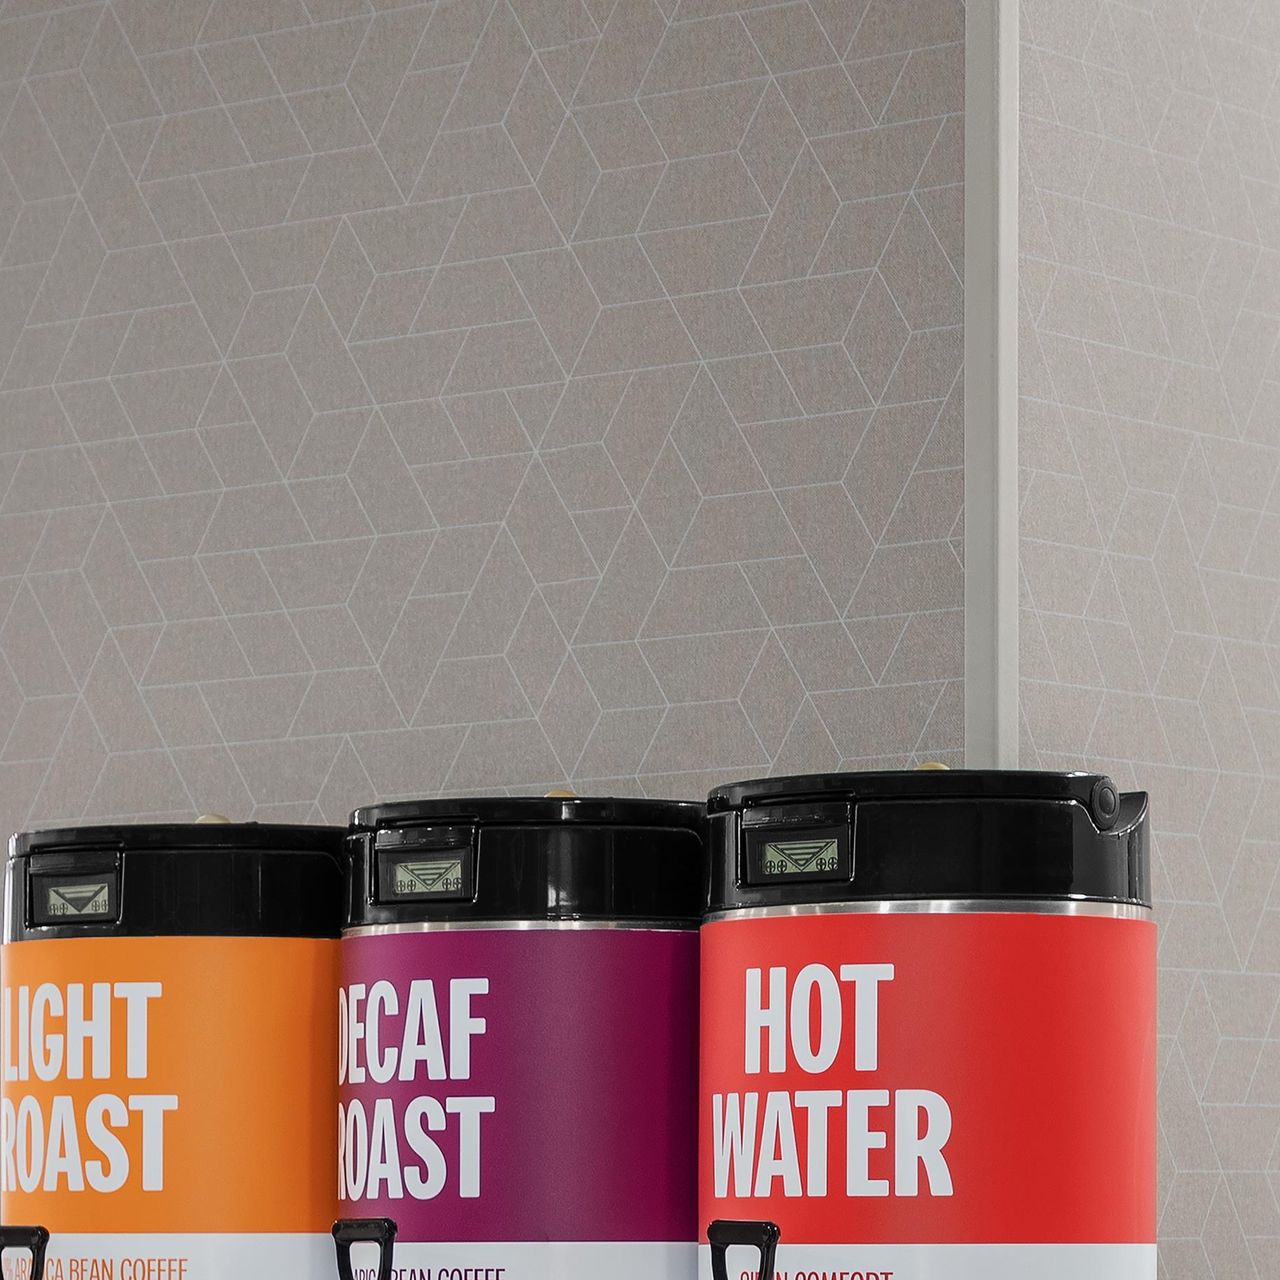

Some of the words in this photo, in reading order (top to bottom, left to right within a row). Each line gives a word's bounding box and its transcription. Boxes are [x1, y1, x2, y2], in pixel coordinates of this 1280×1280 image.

[4, 982, 163, 1082] LIGHT
[338, 977, 490, 1086] DECAF
[744, 963, 895, 1075] HOT
[1, 1093, 179, 1194] ROAST
[712, 1089, 955, 1199] WATER
